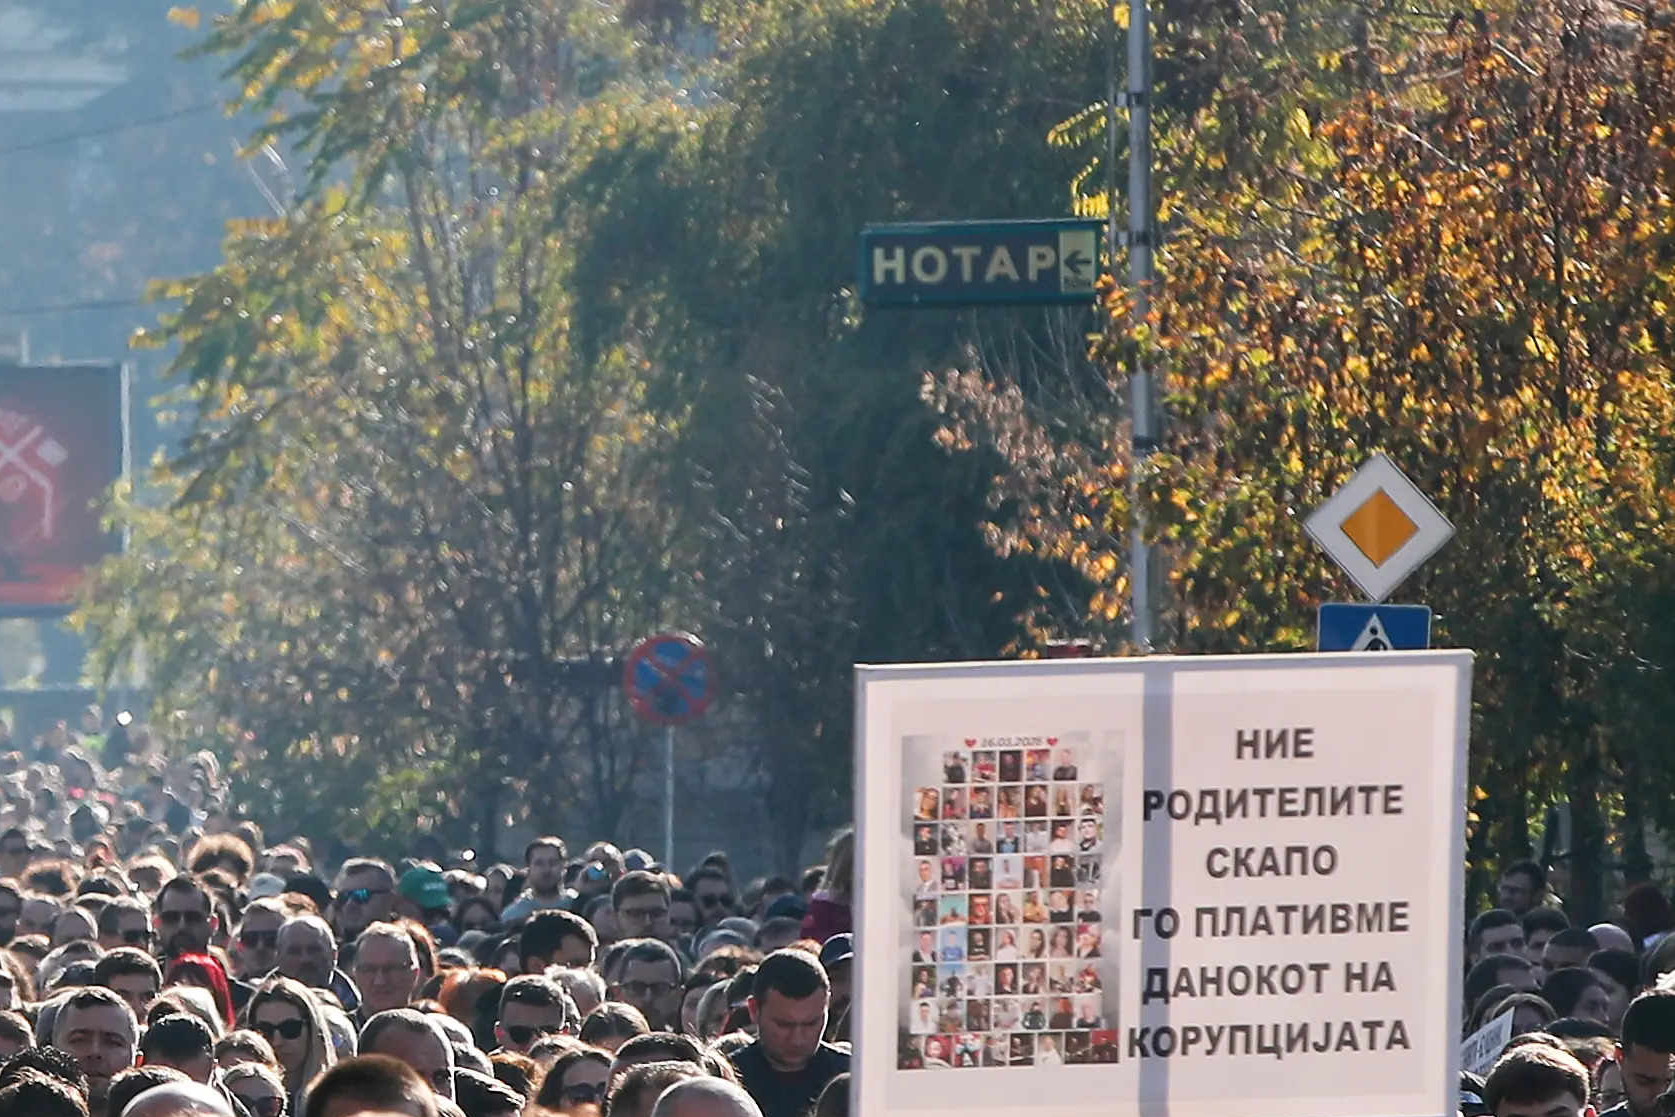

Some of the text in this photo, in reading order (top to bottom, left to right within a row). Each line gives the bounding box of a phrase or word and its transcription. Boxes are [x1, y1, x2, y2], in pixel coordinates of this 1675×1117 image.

[872, 244, 1056, 285] НОТАР
[1236, 728, 1315, 760] НИЕ
[1143, 784, 1404, 825] РОДИТЕЛИТЕ
[1206, 844, 1339, 879] СКАПО
[1133, 901, 1410, 940] ГО ПЛАТИВМЕ
[1142, 961, 1396, 1004] ДАНОКОТ НА
[1127, 1019, 1412, 1059] КОРУПЦИЈАТА
